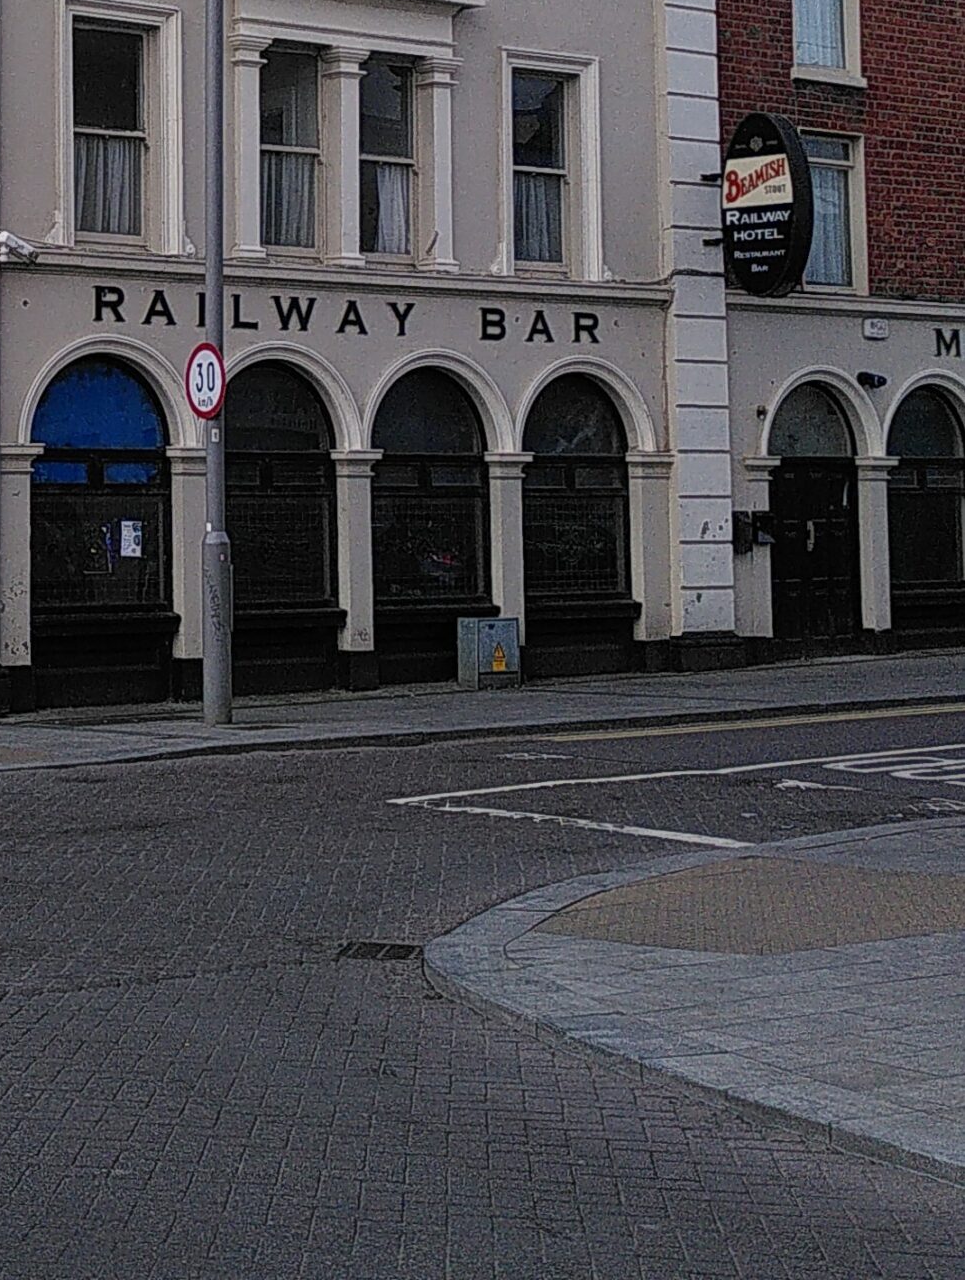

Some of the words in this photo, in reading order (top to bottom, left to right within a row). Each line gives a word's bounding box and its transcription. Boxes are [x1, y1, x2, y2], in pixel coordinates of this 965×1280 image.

[725, 158, 786, 203] BEAMISH
[764, 184, 786, 194] STOUT
[726, 210, 791, 225] RAILWAY
[733, 228, 784, 241] HOTEL
[734, 249, 786, 258] RESTAURANT
[751, 264, 769, 272] BAR
[92, 285, 415, 336] RAILWAY
[479, 307, 600, 343] BAR
[933, 328, 961, 357] M
[196, 361, 215, 393] 30
